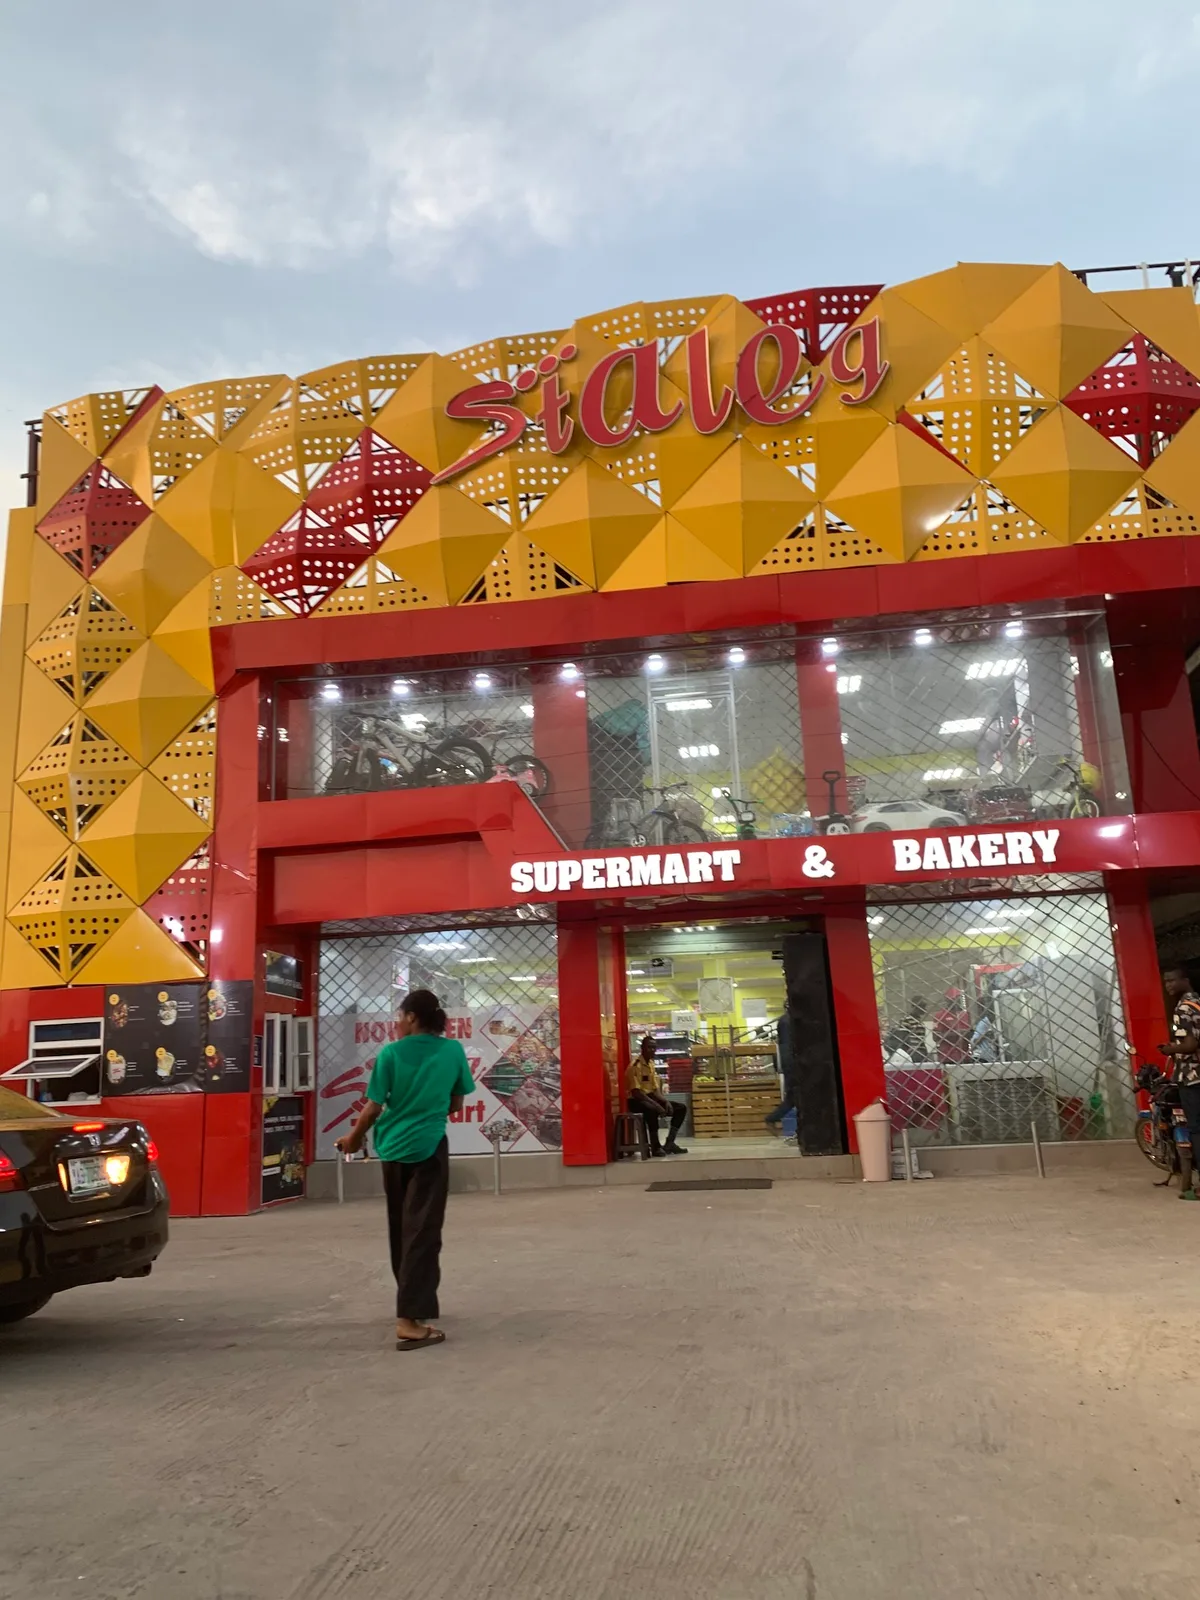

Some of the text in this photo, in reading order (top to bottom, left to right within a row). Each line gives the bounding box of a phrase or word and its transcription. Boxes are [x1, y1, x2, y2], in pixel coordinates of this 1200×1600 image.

[510, 829, 1060, 893] SUPERMART & BAKERY
[677, 1015, 693, 1023] PULL
